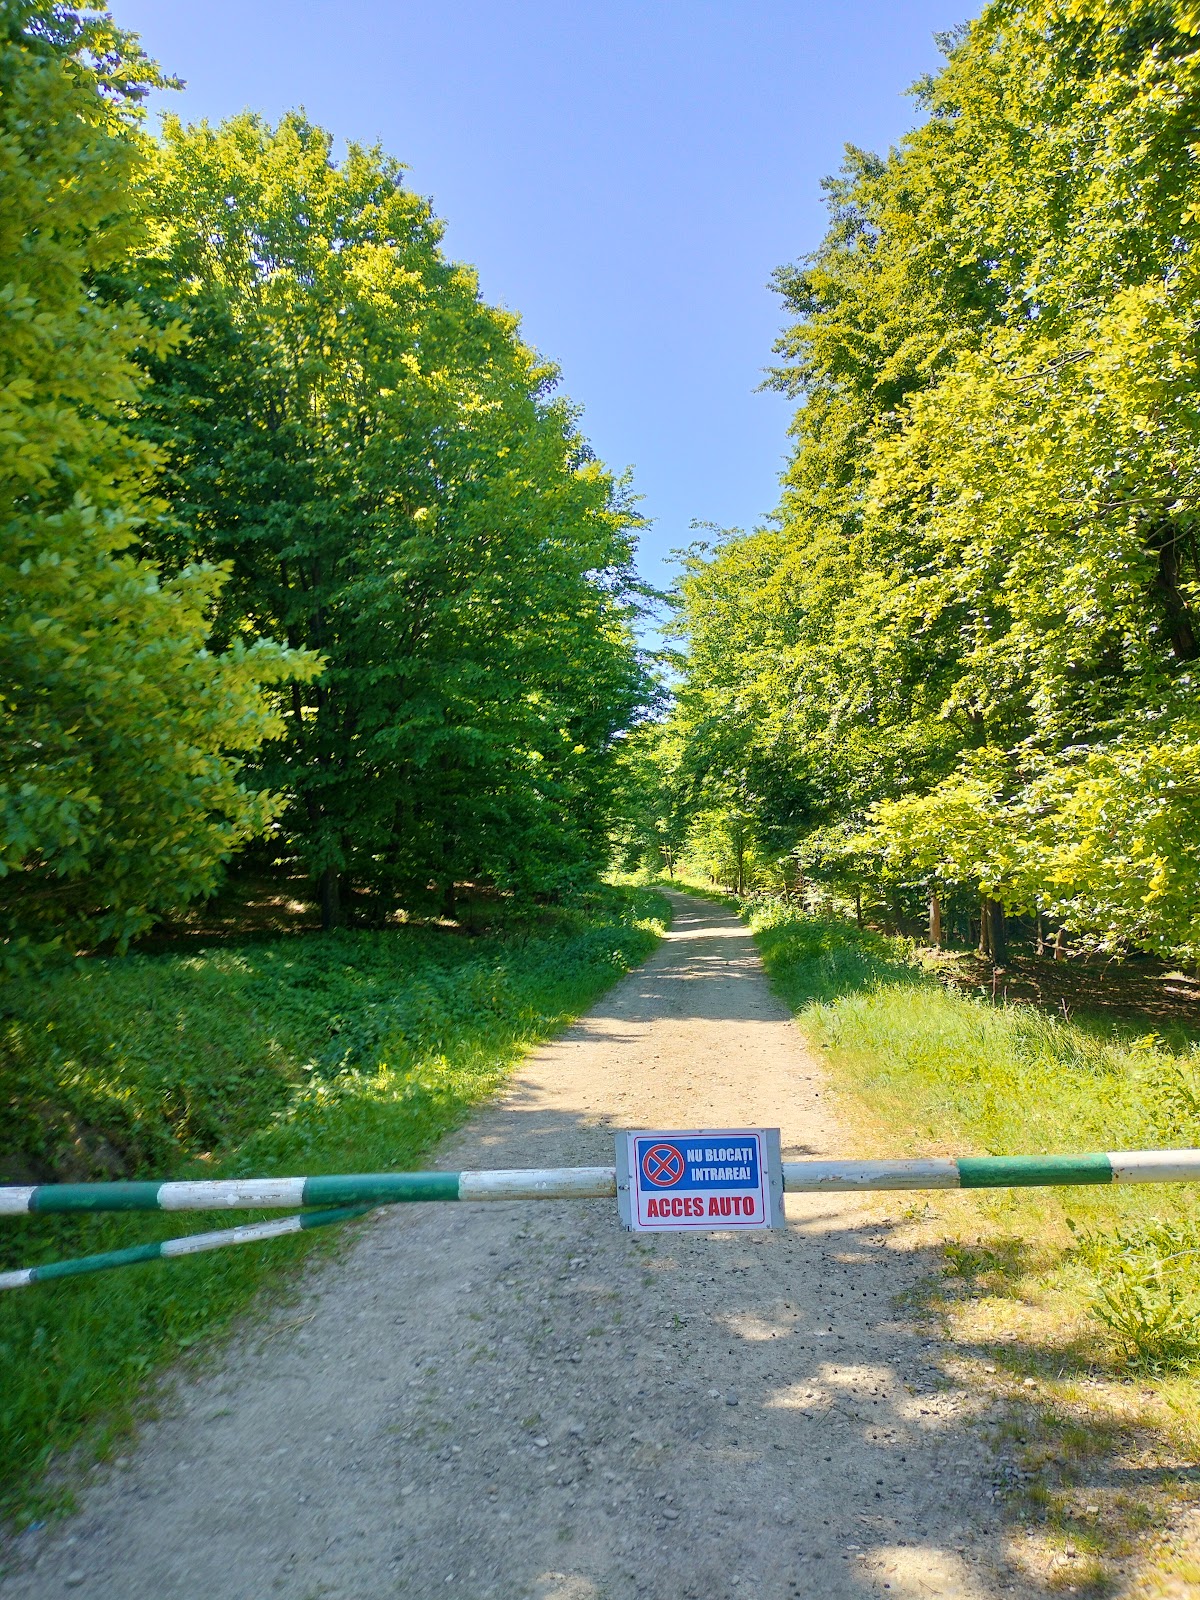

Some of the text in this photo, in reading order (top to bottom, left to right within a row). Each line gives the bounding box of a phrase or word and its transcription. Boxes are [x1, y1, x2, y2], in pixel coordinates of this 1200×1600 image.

[687, 1149, 703, 1163] NU
[691, 1167, 751, 1181] INTRAREA!
[647, 1196, 755, 1218] ACCES AUTO
